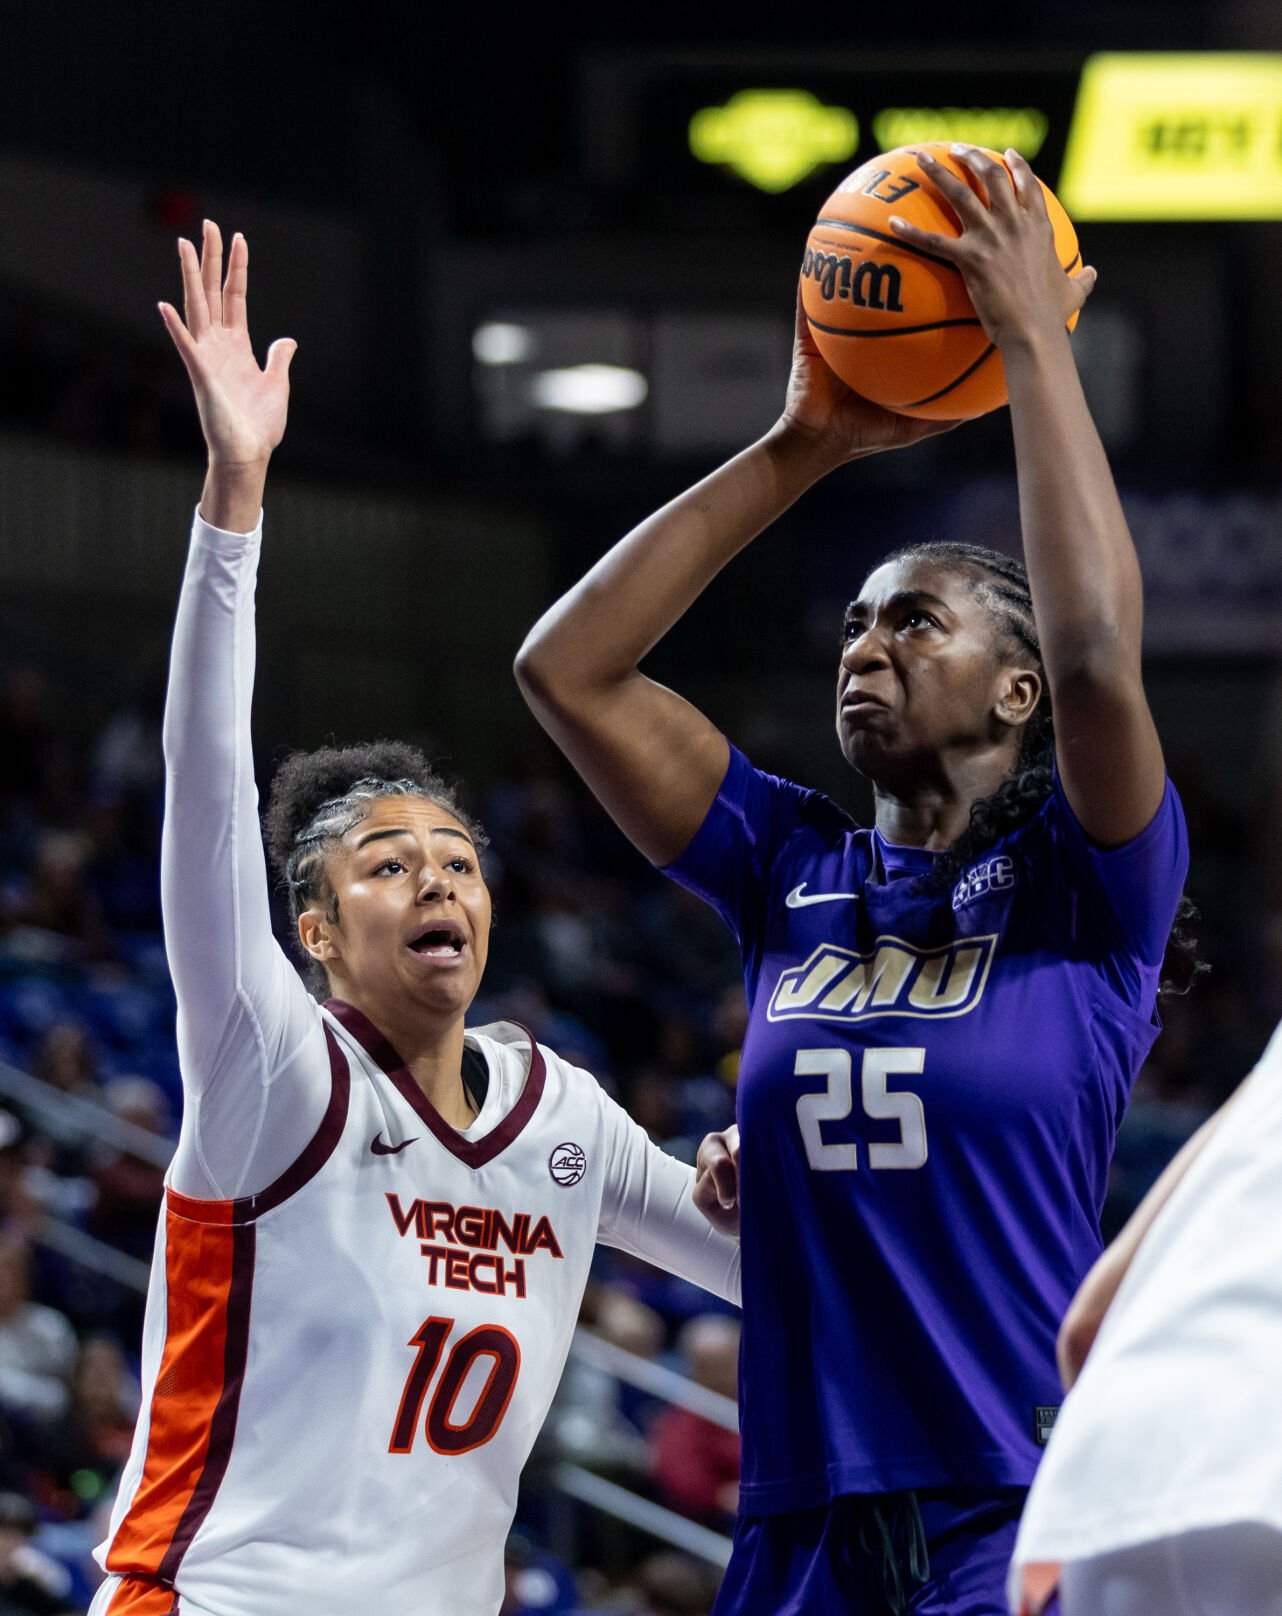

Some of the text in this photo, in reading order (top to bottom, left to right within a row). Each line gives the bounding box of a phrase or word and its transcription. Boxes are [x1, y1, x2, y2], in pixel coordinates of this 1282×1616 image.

[846, 167, 921, 205] EV
[802, 248, 904, 313] Wilso
[772, 941, 986, 1016] JMU
[793, 1047, 929, 1171] 25
[554, 1156, 586, 1168] ACC
[384, 1192, 565, 1259] VIRGINIA
[420, 1243, 527, 1299] TECH
[387, 1315, 522, 1457] 10
